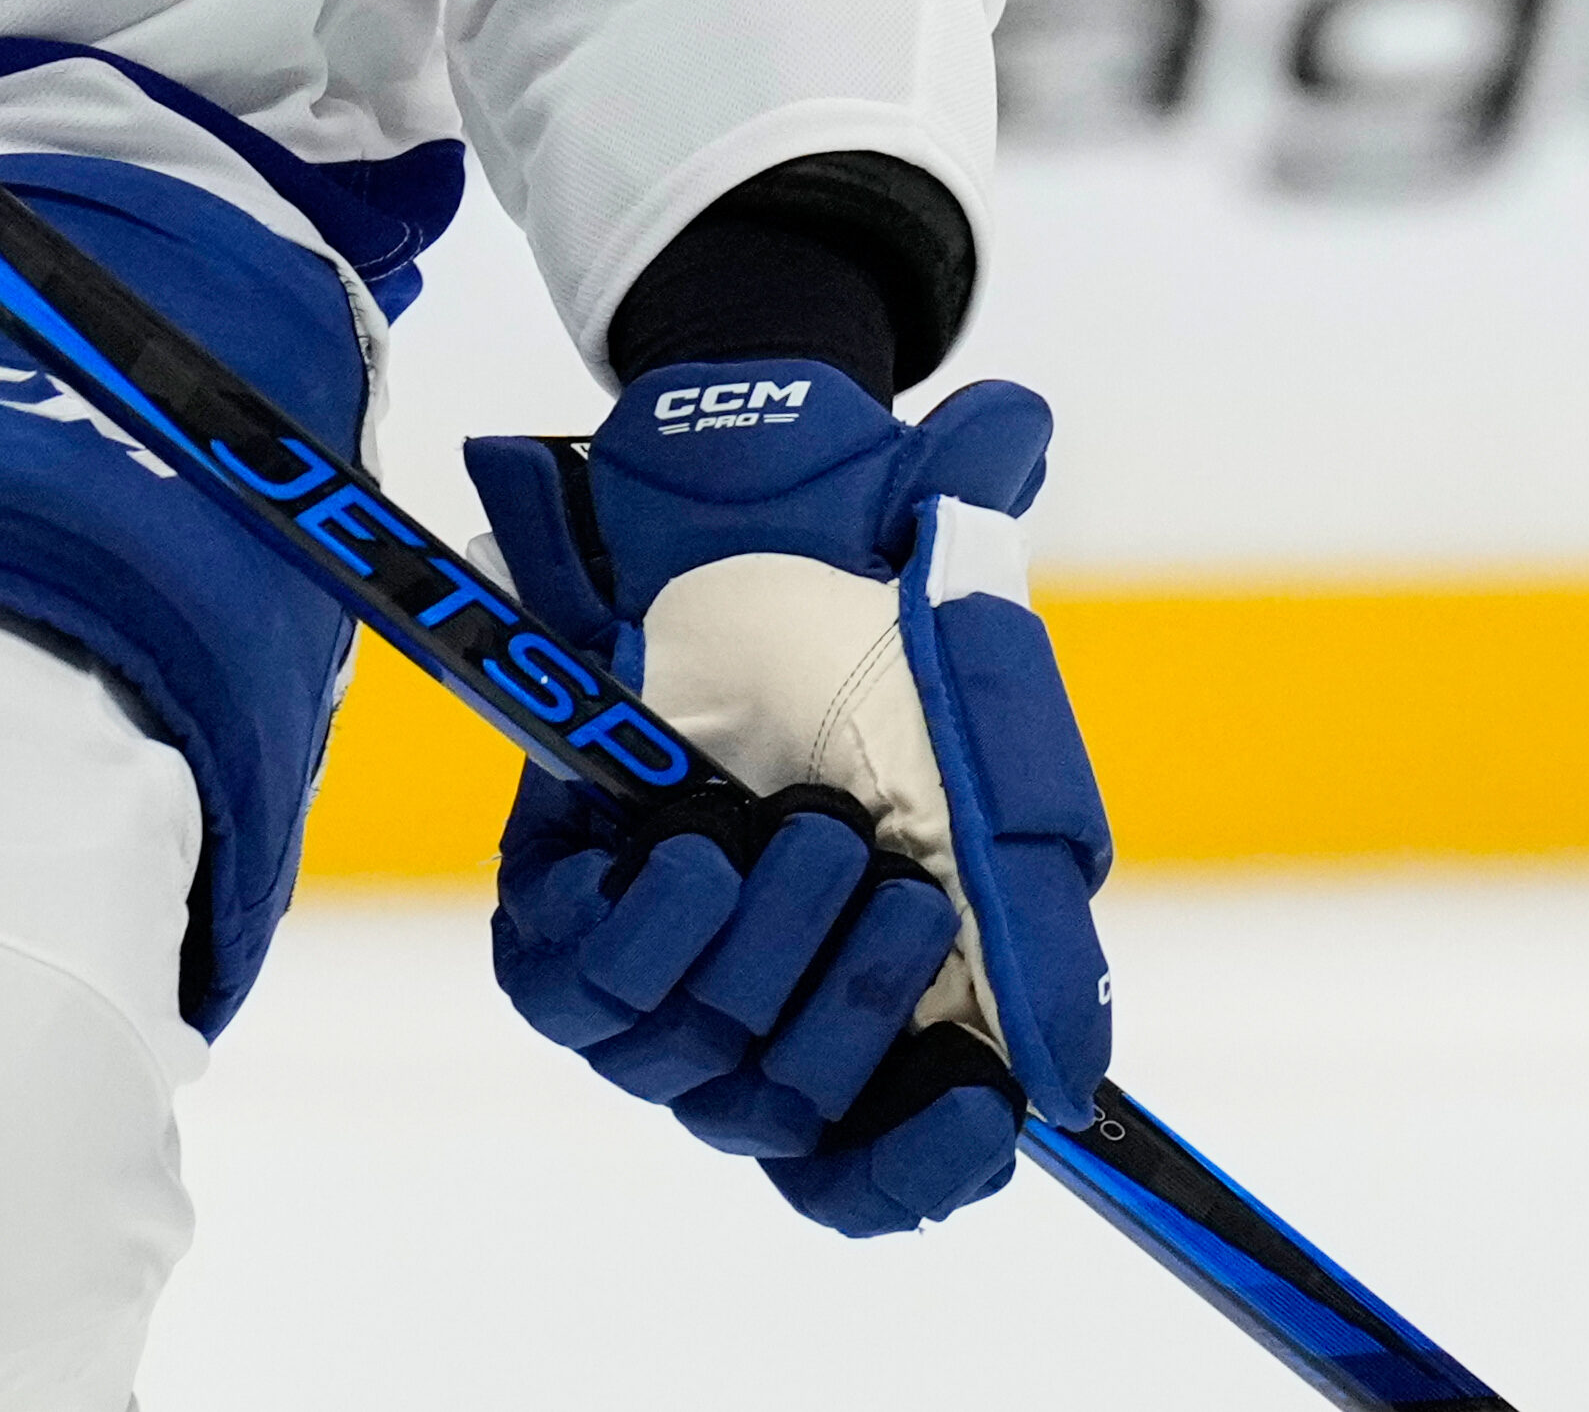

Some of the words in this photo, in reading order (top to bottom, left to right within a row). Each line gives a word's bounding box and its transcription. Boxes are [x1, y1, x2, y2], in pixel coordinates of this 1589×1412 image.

[653, 380, 812, 421] CCM
[694, 412, 760, 432] PRO
[211, 437, 690, 787] JETSP
